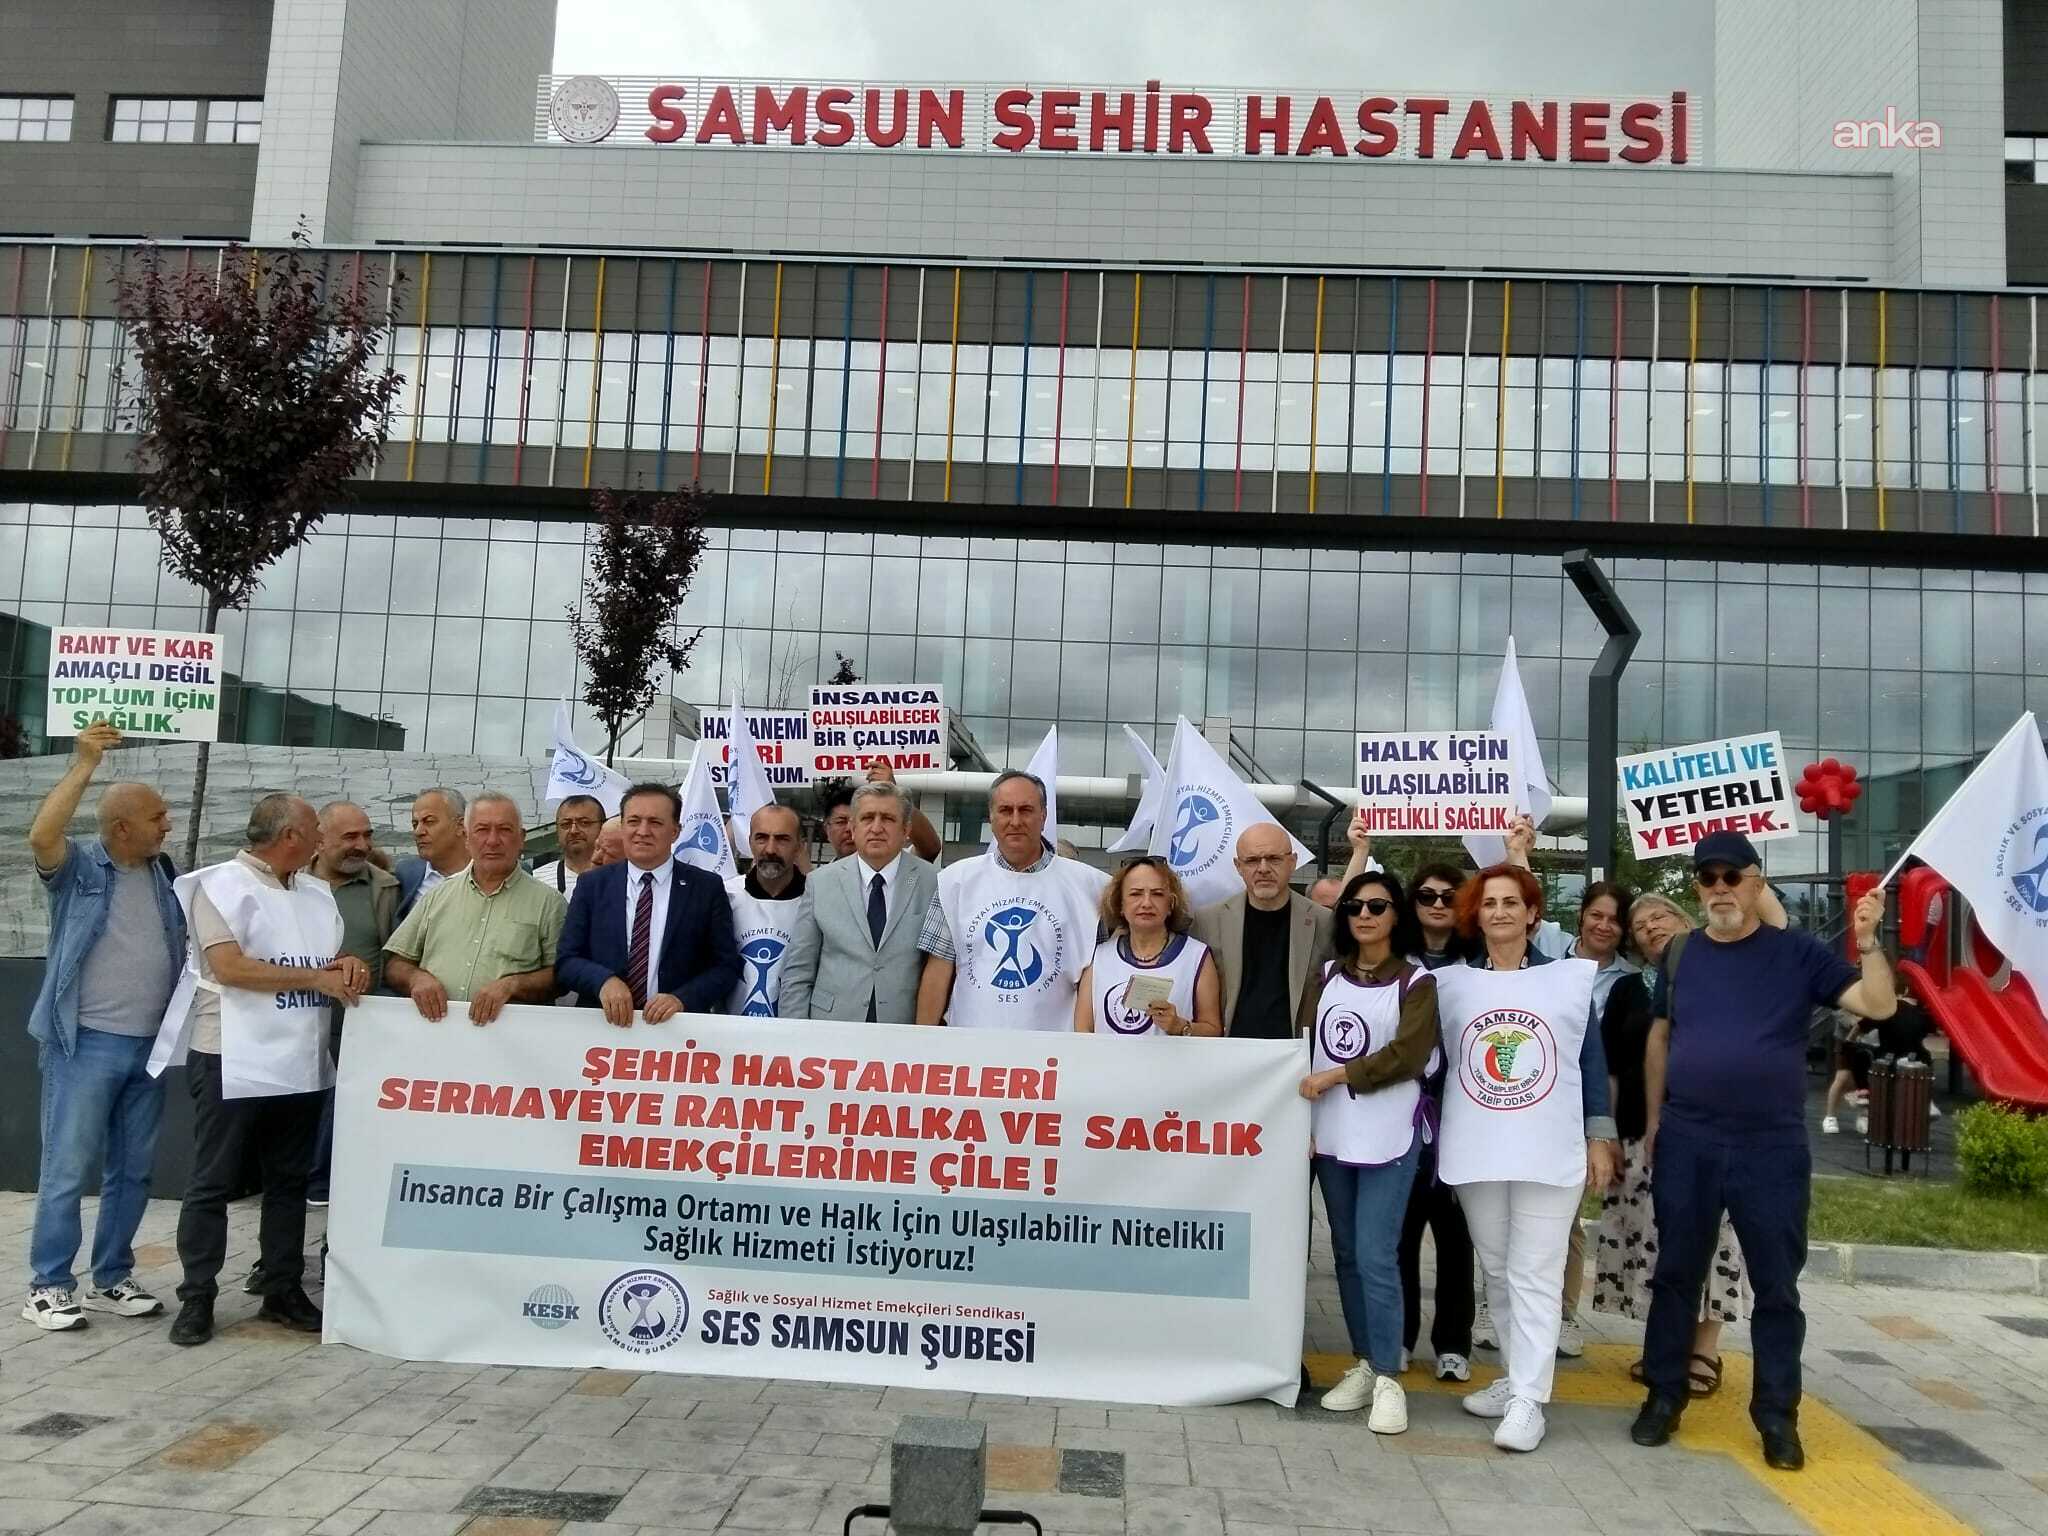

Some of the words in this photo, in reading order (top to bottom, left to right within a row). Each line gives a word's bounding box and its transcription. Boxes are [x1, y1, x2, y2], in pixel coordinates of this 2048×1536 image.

[644, 85, 966, 148] SAMSUN
[993, 79, 1214, 153] ŞEHİR
[1245, 92, 1687, 165] HASTANESİ
[58, 634, 121, 654] RANT
[127, 636, 156, 657] VE
[164, 638, 213, 661] KAR
[54, 660, 141, 684] AMAÇLI
[150, 661, 215, 685] DEĞİL
[52, 687, 155, 707] TOPLUM
[163, 687, 215, 714] İÇİN
[812, 689, 940, 705] İNSANCA
[703, 712, 808, 740] HAANEMİ
[812, 707, 941, 730] ÇALIŞILABİLECEK
[814, 727, 846, 747] BİR
[853, 729, 941, 751] ÇALIŞMA
[1360, 740, 1440, 763] HALK
[1448, 734, 1509, 768] İÇİN
[1623, 743, 1737, 791] KALİTELİ
[1740, 742, 1778, 771] VE
[1360, 767, 1510, 802] ULAŞILABİLİR
[1630, 770, 1785, 823] YETERLİ
[1360, 801, 1439, 831] NİTELİKLİ
[997, 994, 1020, 1003] SES
[1473, 1013, 1540, 1032] SAMSUN
[582, 1039, 721, 1085] ŞEHİR
[730, 1054, 1059, 1101] HASTANELERİ
[1477, 1090, 1502, 1106] TABİP
[1503, 1091, 1536, 1106] ODASI
[377, 1077, 663, 1126] SERMAYEYE
[673, 1095, 815, 1140] RANT,
[828, 1102, 988, 1143] HALKA
[1000, 1110, 1062, 1147] VE
[1084, 1110, 1264, 1158] SAĞLIK
[578, 1131, 918, 1184] EMEKÇİLERİNE
[929, 1143, 1031, 1194] ÇİLE
[1043, 1158, 1059, 1197] !
[399, 1170, 503, 1209] İnsanca
[514, 1182, 554, 1212] Bir
[563, 1185, 668, 1223] Çalışma
[676, 1192, 771, 1226] Ortamı
[780, 1206, 811, 1227] ve
[821, 1202, 882, 1232] Halk
[892, 1198, 941, 1242] İçin
[951, 1209, 1103, 1248] Ulaşılabilir
[1111, 1217, 1225, 1252] Nitelikli
[643, 1225, 722, 1261] Sağlık
[732, 1232, 836, 1265] Hizmeti
[846, 1232, 976, 1275] İstiyoruz!
[522, 1302, 580, 1320] KESK
[707, 1288, 749, 1305] Sağlık
[753, 1294, 770, 1305] ve
[772, 1293, 818, 1310] Sosyal
[822, 1296, 873, 1312] Hizmet
[876, 1300, 952, 1318] Emekçileri
[955, 1305, 1026, 1321] Sendikası
[602, 1327, 641, 1354] SAMSUN
[700, 1309, 762, 1347] SES
[771, 1314, 910, 1356] SAMSUN
[920, 1321, 1037, 1371] ŞUBESİ
